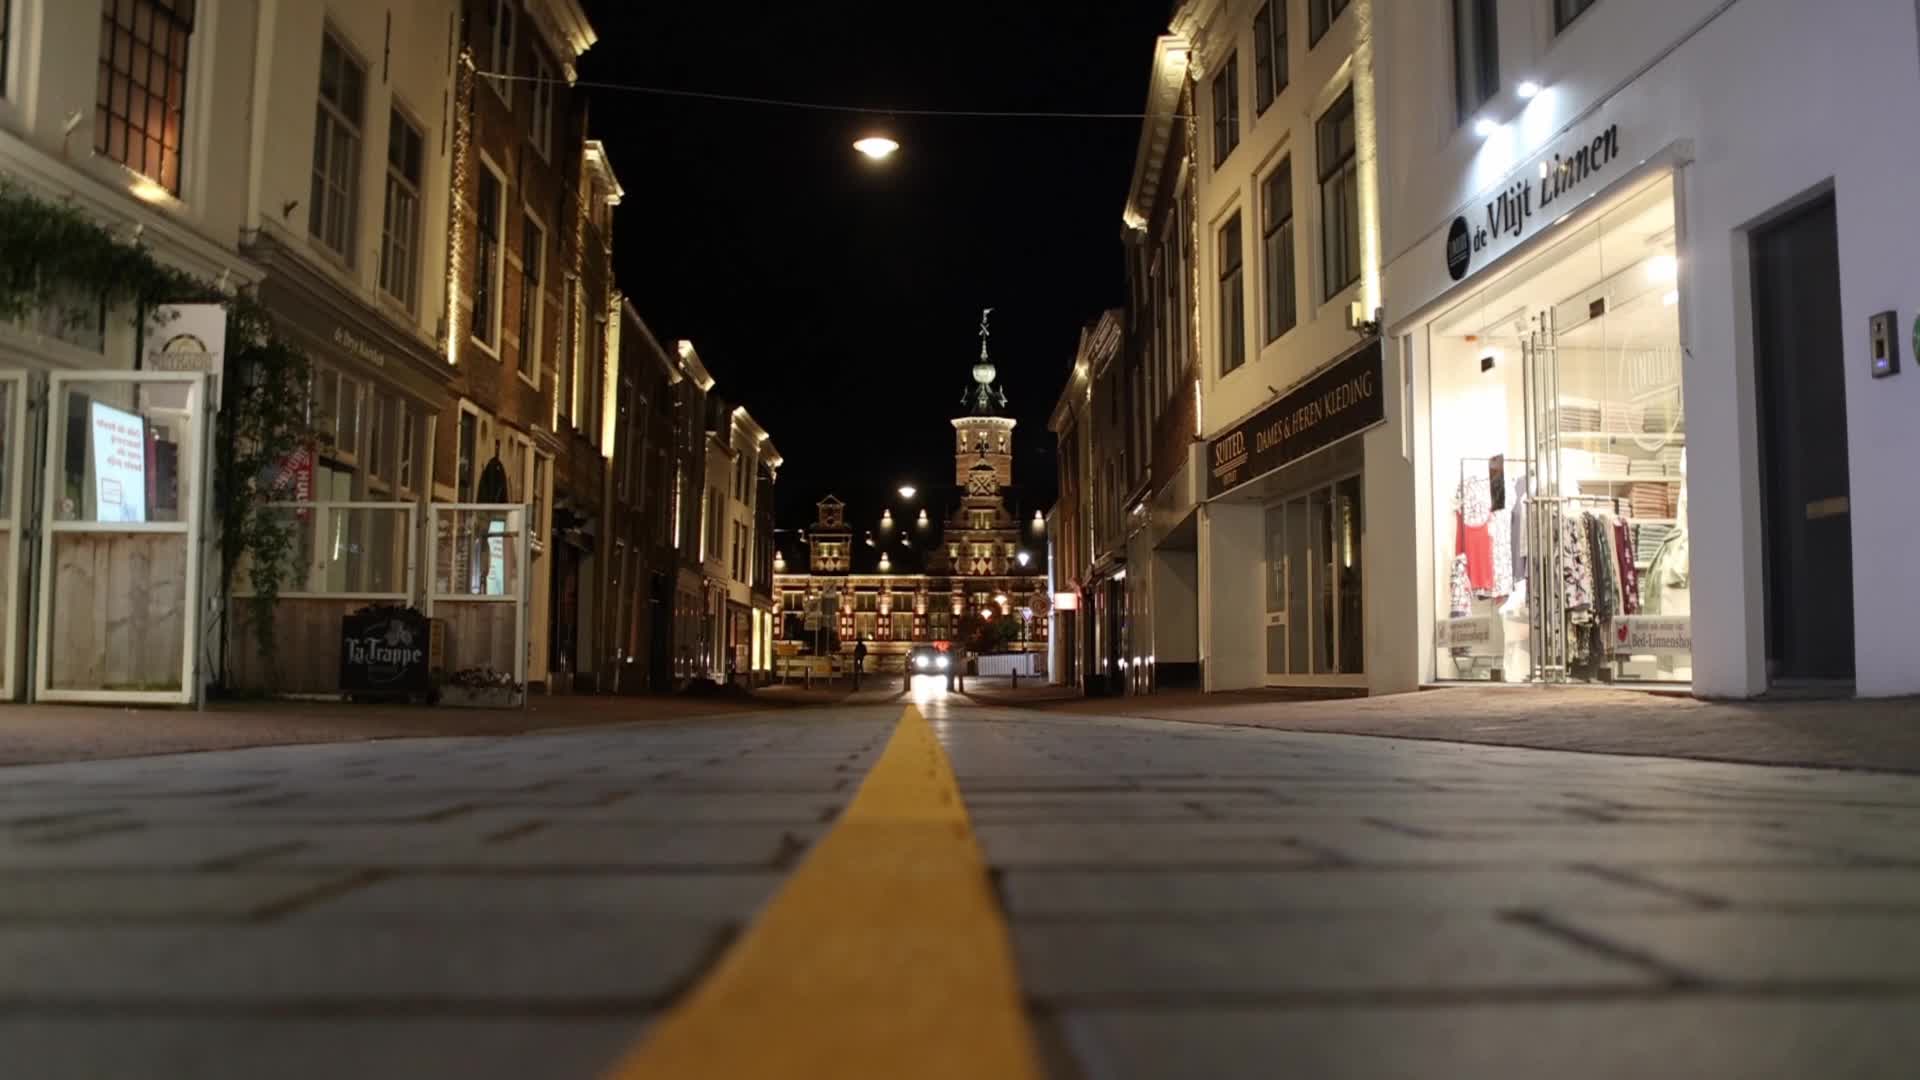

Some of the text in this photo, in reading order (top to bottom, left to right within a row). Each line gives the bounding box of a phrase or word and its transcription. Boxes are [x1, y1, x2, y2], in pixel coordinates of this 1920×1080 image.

[1473, 225, 1488, 252] de
[1487, 178, 1532, 238] Vlijt
[1538, 123, 1619, 209] Linnen
[1256, 370, 1373, 454] DAMES & HEREN KLEDING
